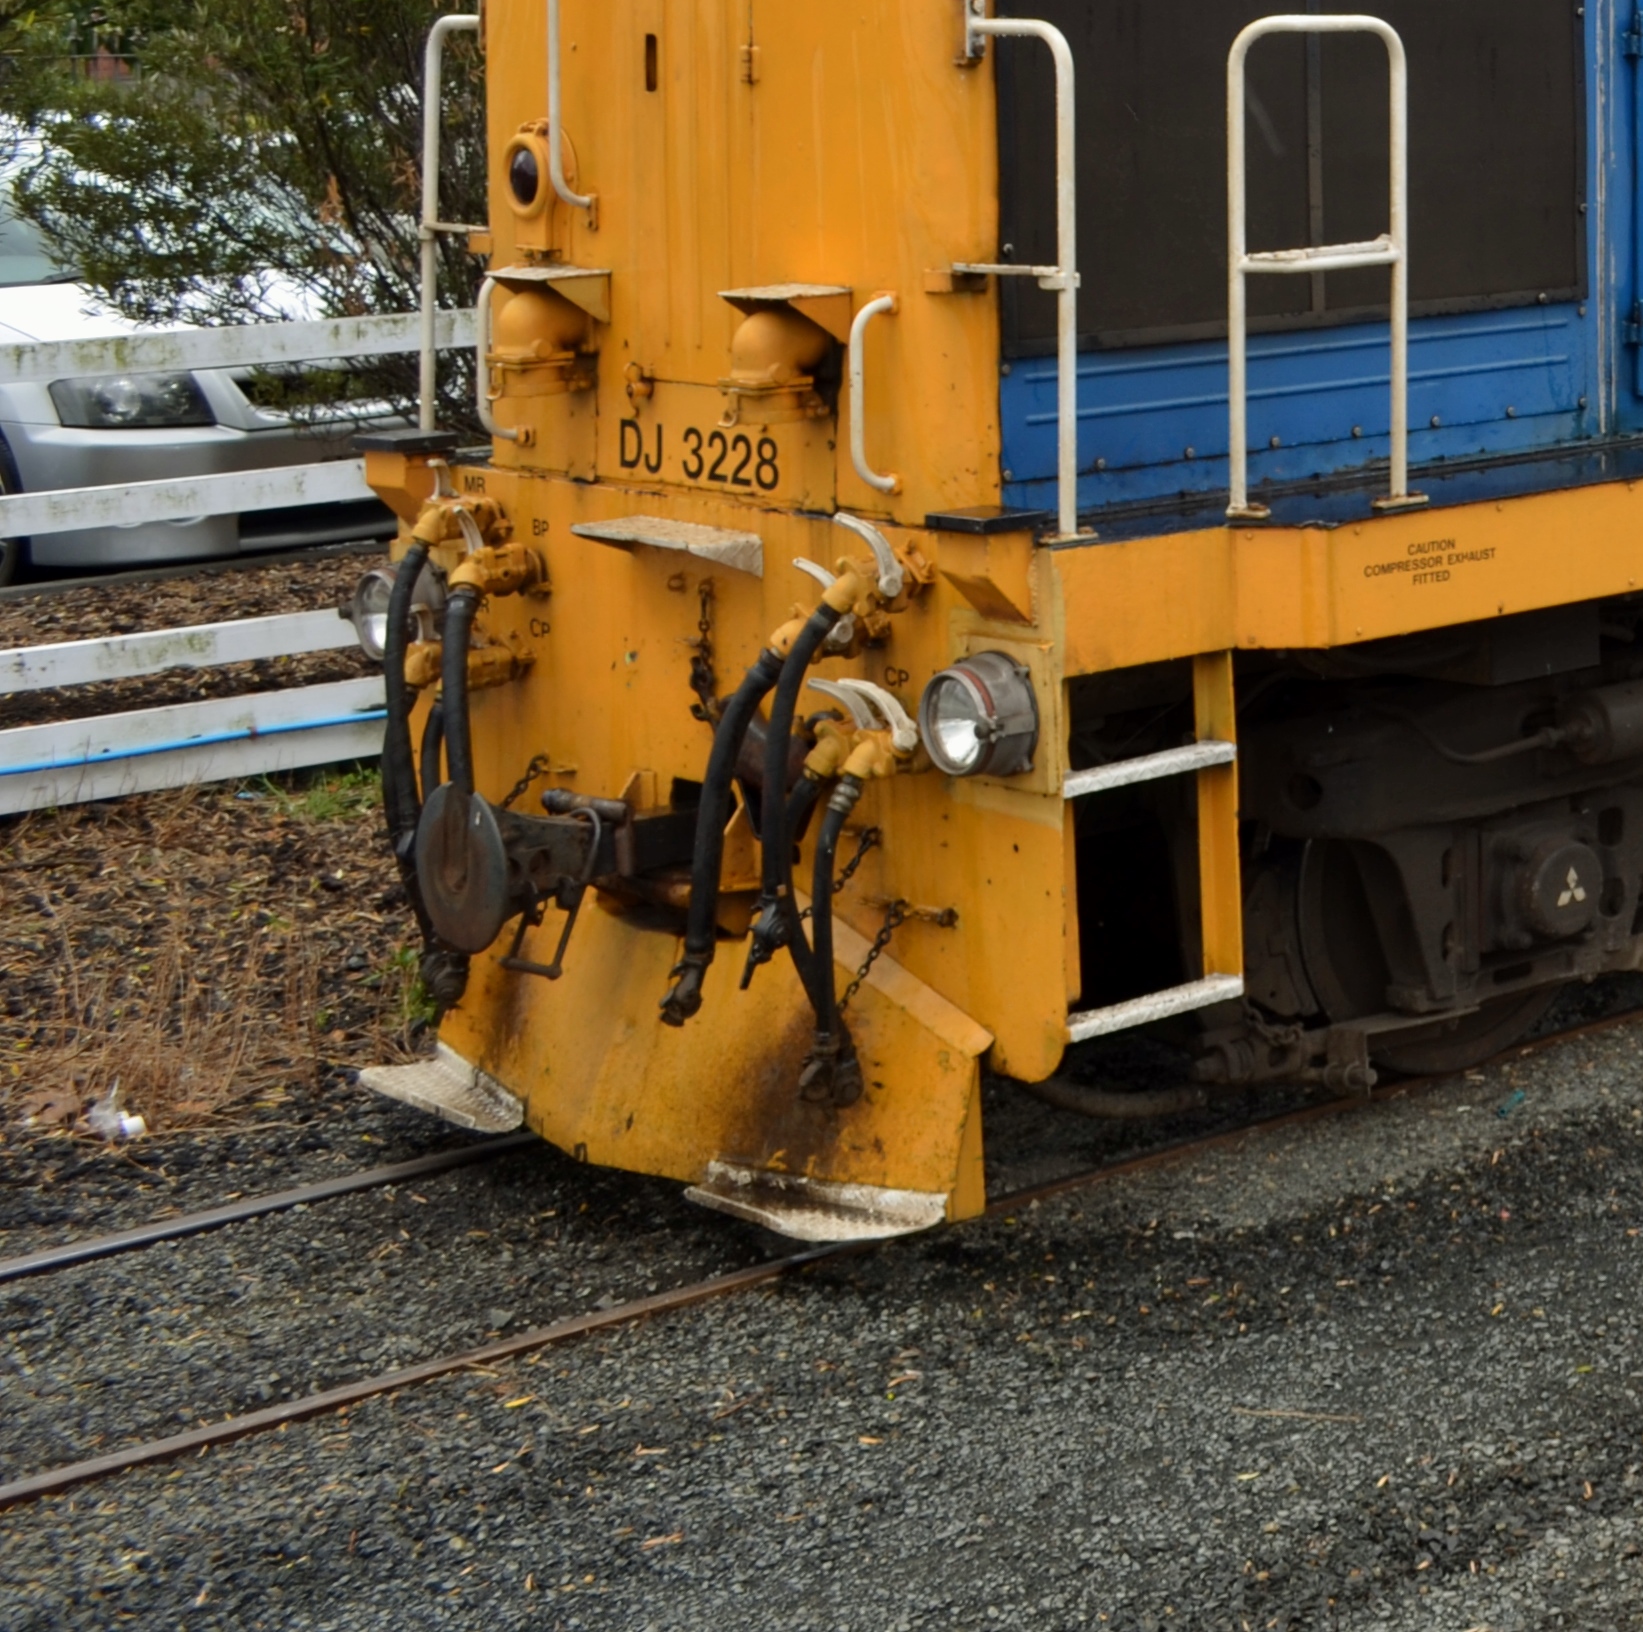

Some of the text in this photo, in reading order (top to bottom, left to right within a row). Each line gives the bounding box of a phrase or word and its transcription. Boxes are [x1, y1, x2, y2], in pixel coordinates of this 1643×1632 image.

[620, 418, 779, 491] DJ 3228
[464, 475, 486, 493] MR
[532, 518, 549, 537] BP
[1407, 538, 1456, 556] CAUTION
[1363, 547, 1496, 578] COMPRESSOR EXHAUST
[1412, 569, 1450, 585] FITTED
[529, 618, 550, 638] CP
[884, 666, 910, 688] CP
